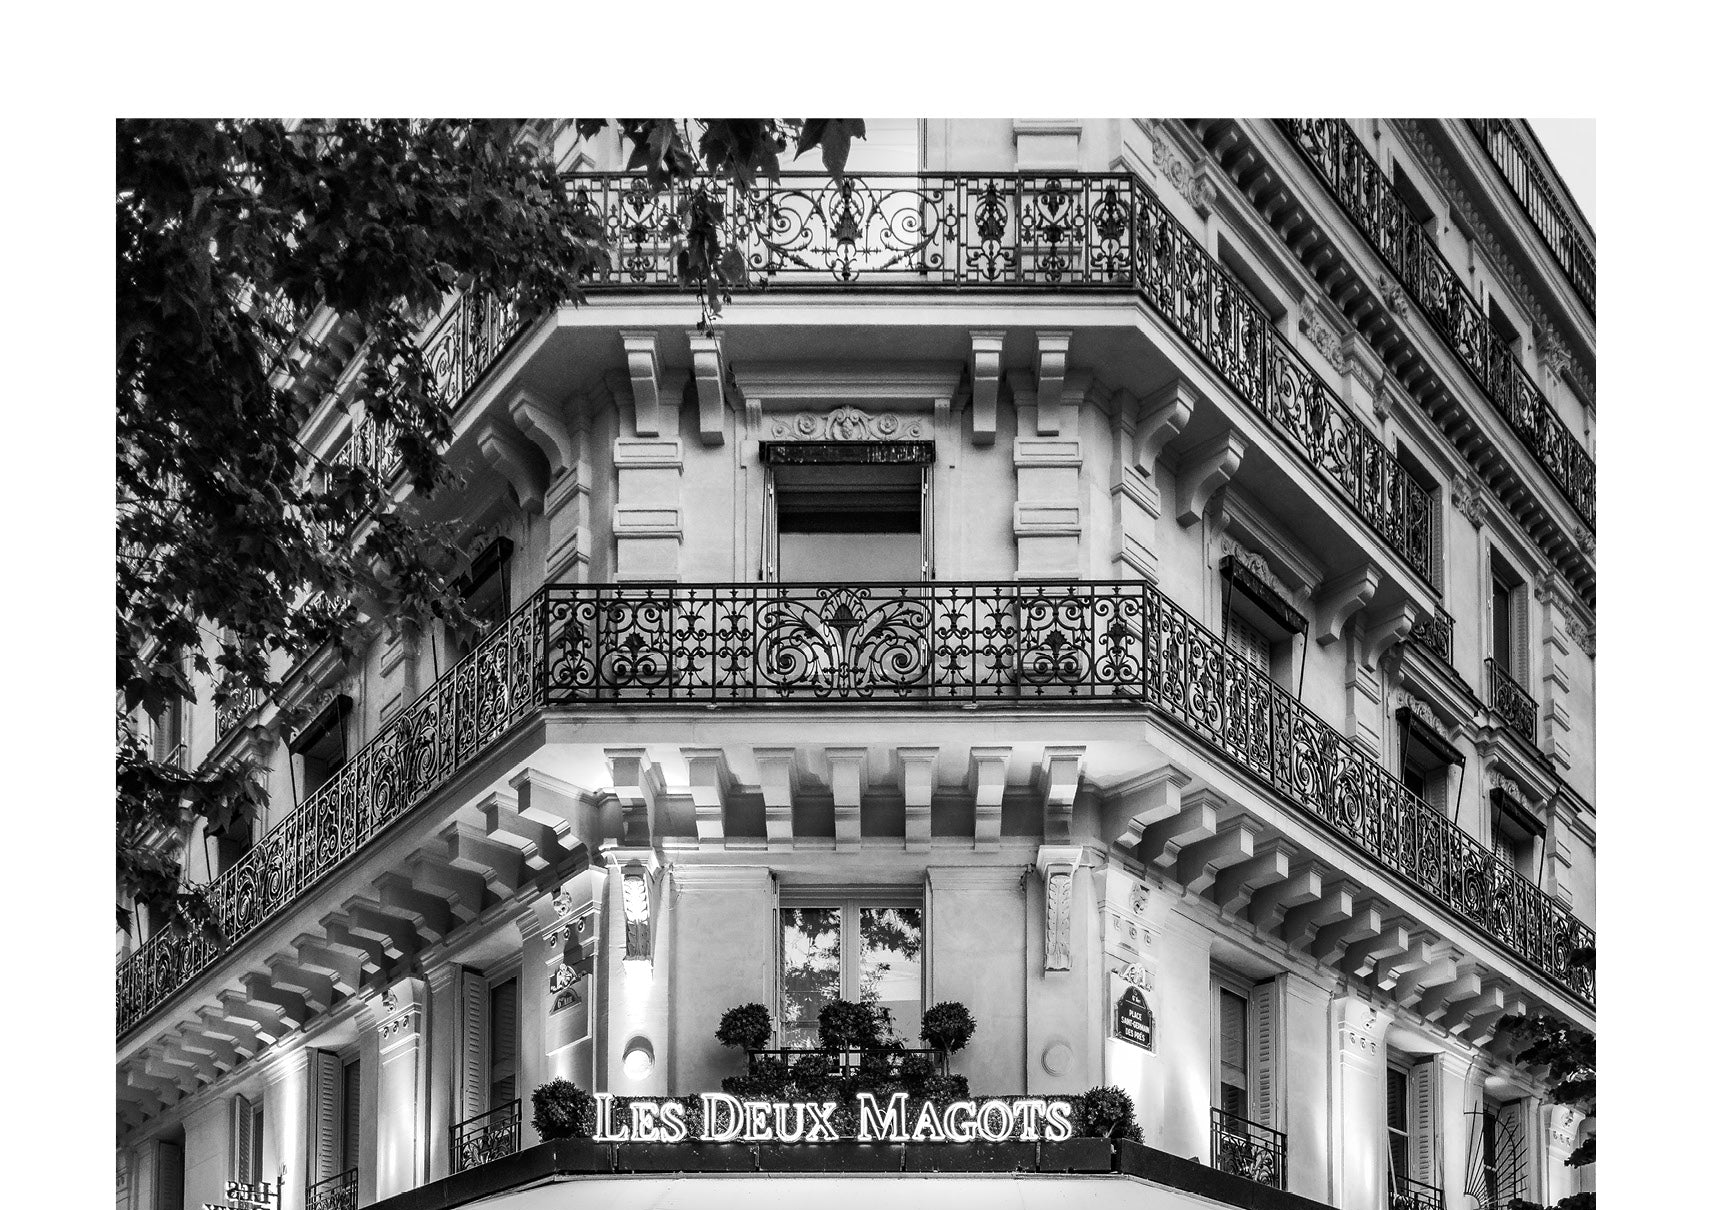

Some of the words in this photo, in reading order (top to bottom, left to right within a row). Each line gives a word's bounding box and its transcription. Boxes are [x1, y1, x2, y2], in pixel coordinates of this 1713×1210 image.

[1128, 1008, 1142, 1021] PLACE
[1120, 1015, 1150, 1034] SAINT-GERMAIN
[1125, 1027, 1134, 1038] DES
[1133, 1029, 1146, 1042] PRÉS
[592, 1092, 688, 1142] LES
[700, 1092, 839, 1143] DEUX
[856, 1092, 1073, 1143] MAGOTS
